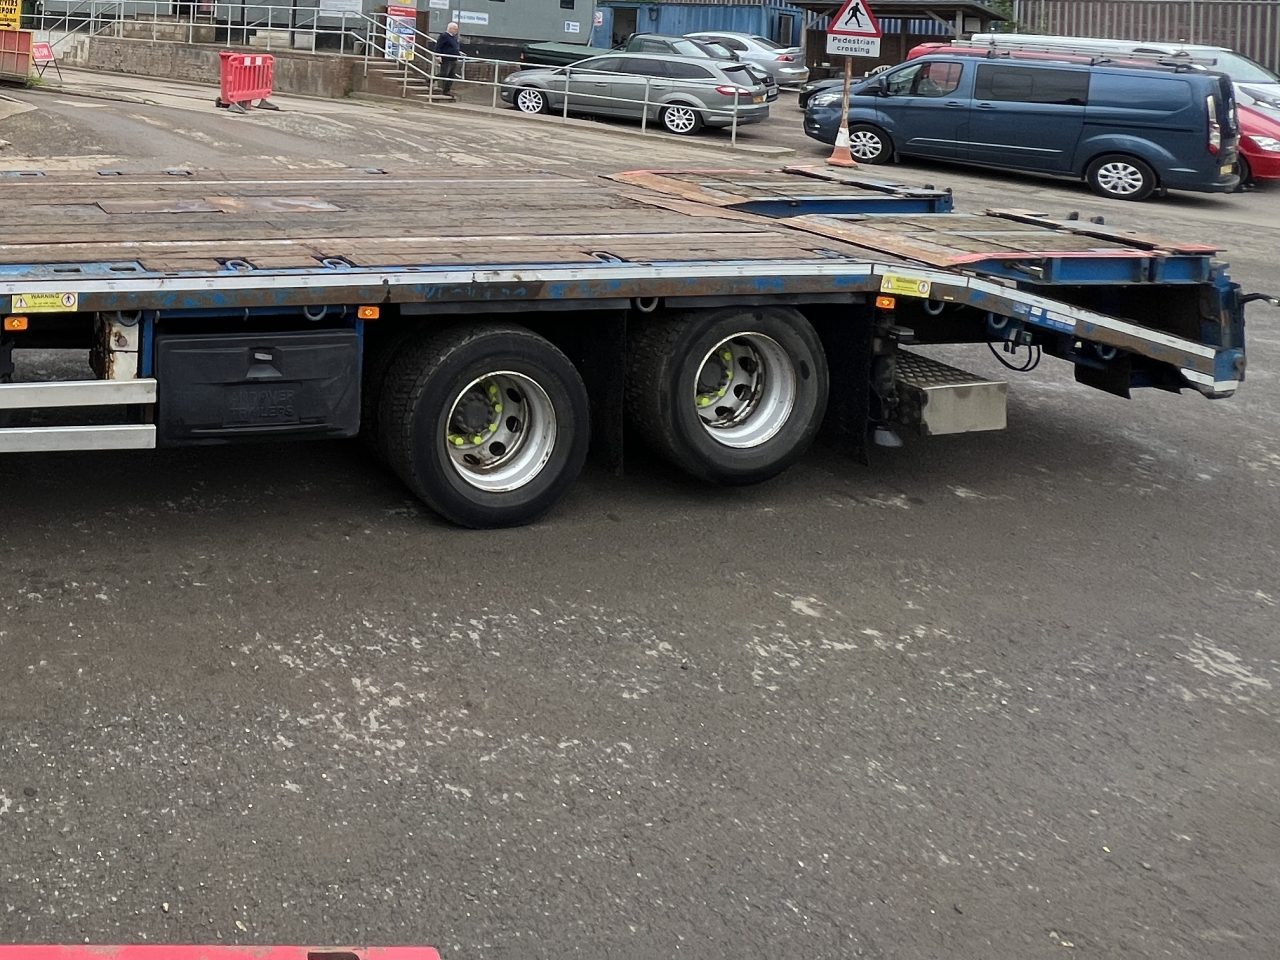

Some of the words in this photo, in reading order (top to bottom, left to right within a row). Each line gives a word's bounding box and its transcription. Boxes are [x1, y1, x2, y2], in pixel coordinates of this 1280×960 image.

[832, 36, 876, 46] Pedestrian
[836, 46, 870, 54] crossing
[231, 390, 295, 401] ANDOVER
[229, 405, 295, 418] TRAILERS
